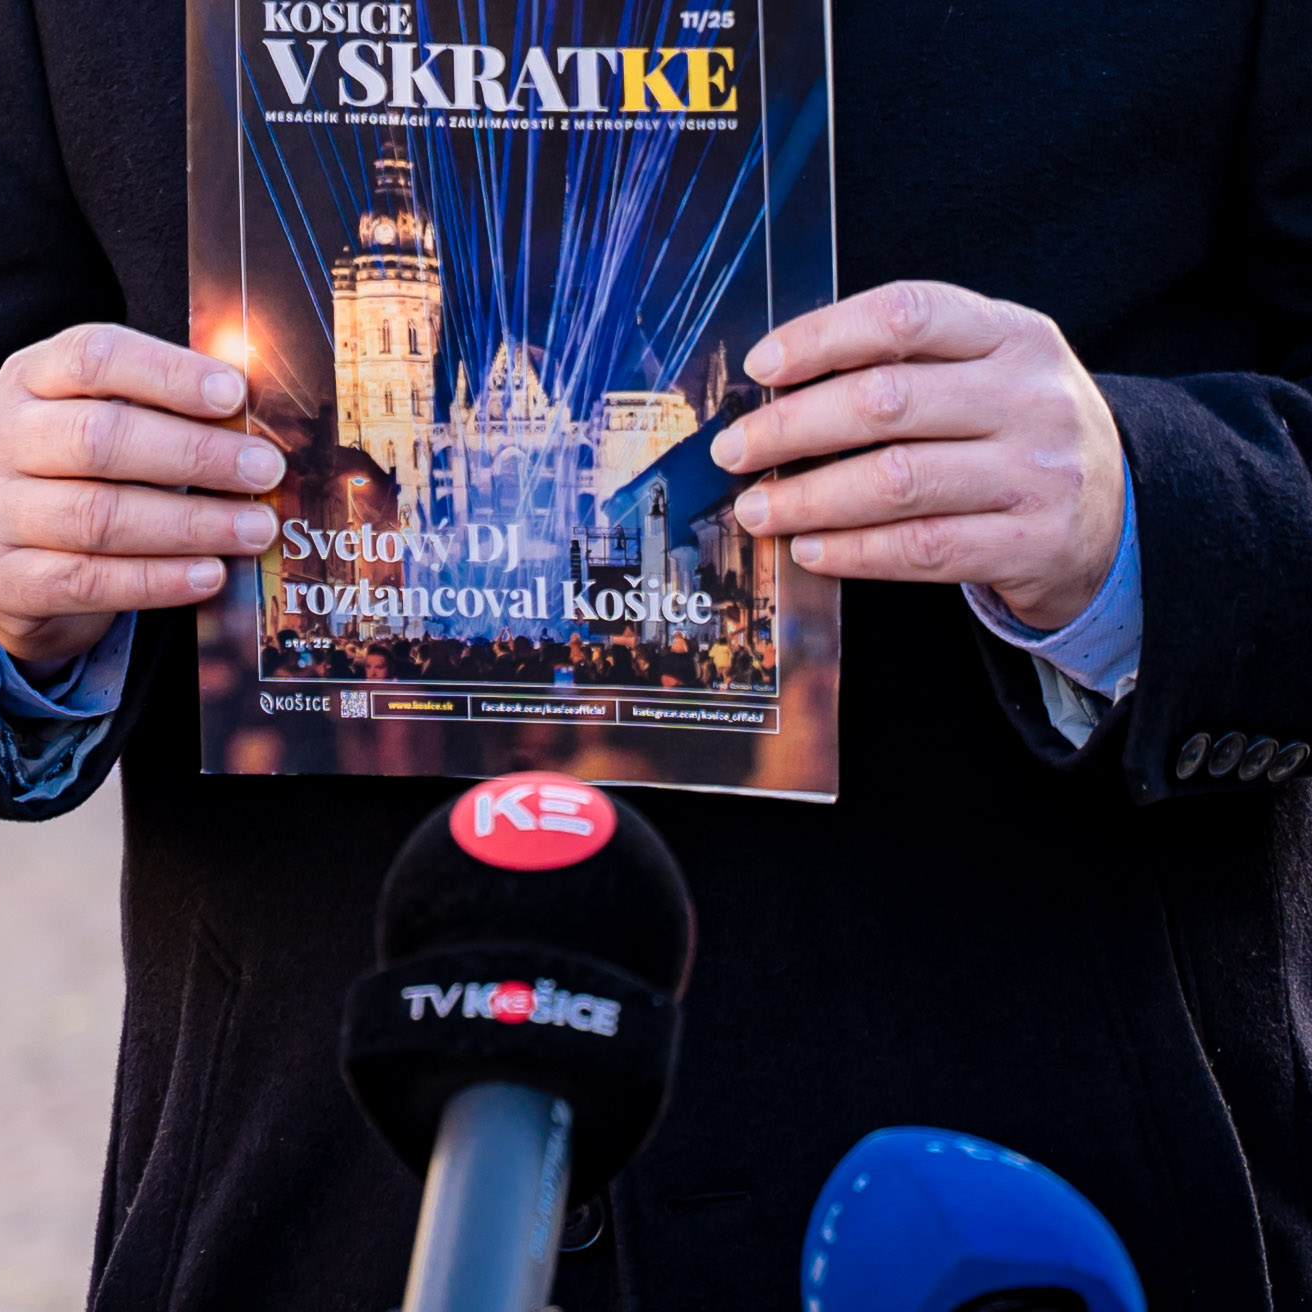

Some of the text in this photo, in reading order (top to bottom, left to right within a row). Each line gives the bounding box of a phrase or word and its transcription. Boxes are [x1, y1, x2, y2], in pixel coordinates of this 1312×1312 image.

[680, 10, 735, 33] 11/25
[262, 38, 737, 112] V SKRATKE
[265, 110, 338, 124] MESAČNÍK
[436, 115, 445, 127] A
[560, 118, 570, 131] Z
[574, 118, 660, 131] METROPOLY
[667, 116, 738, 132] VÝCHODU
[282, 518, 520, 573] Svetový DJ
[283, 574, 713, 625] roztancoval Košice
[275, 693, 331, 712] KOŠICE
[388, 700, 454, 711] www.kosice.sk
[474, 784, 594, 837] KE
